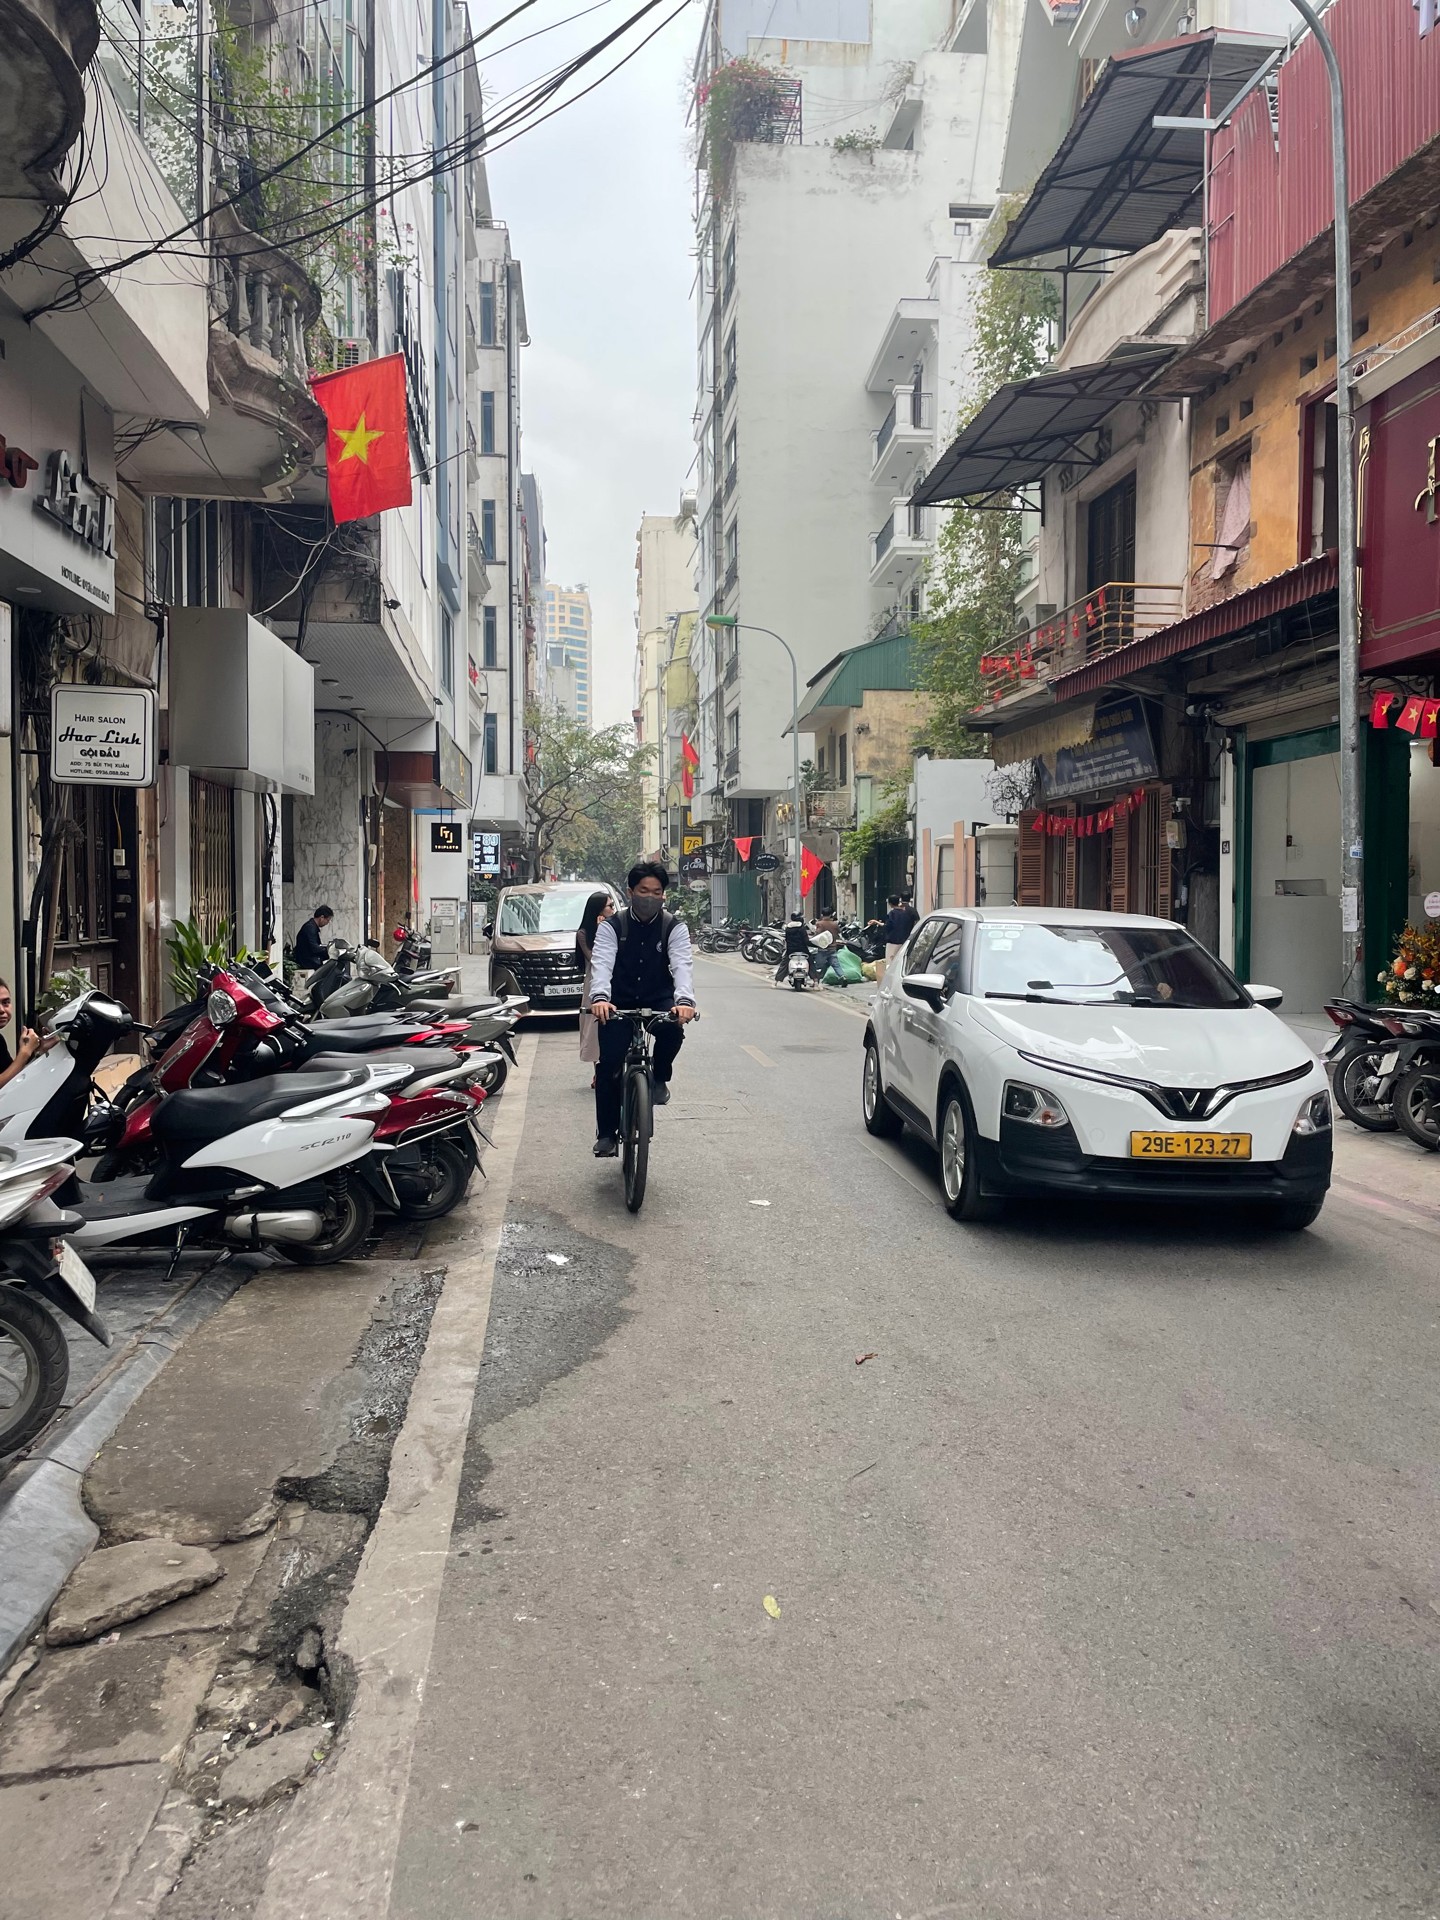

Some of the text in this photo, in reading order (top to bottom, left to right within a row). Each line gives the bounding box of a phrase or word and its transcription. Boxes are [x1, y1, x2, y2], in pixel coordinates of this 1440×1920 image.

[74, 713, 126, 724] HAIR SALON
[58, 726, 142, 745] Hao Linh
[80, 747, 98, 759] GỘI
[482, 834, 498, 847] 89
[685, 839, 700, 850] 76
[1142, 1137, 1240, 1155] 29E-123.27
